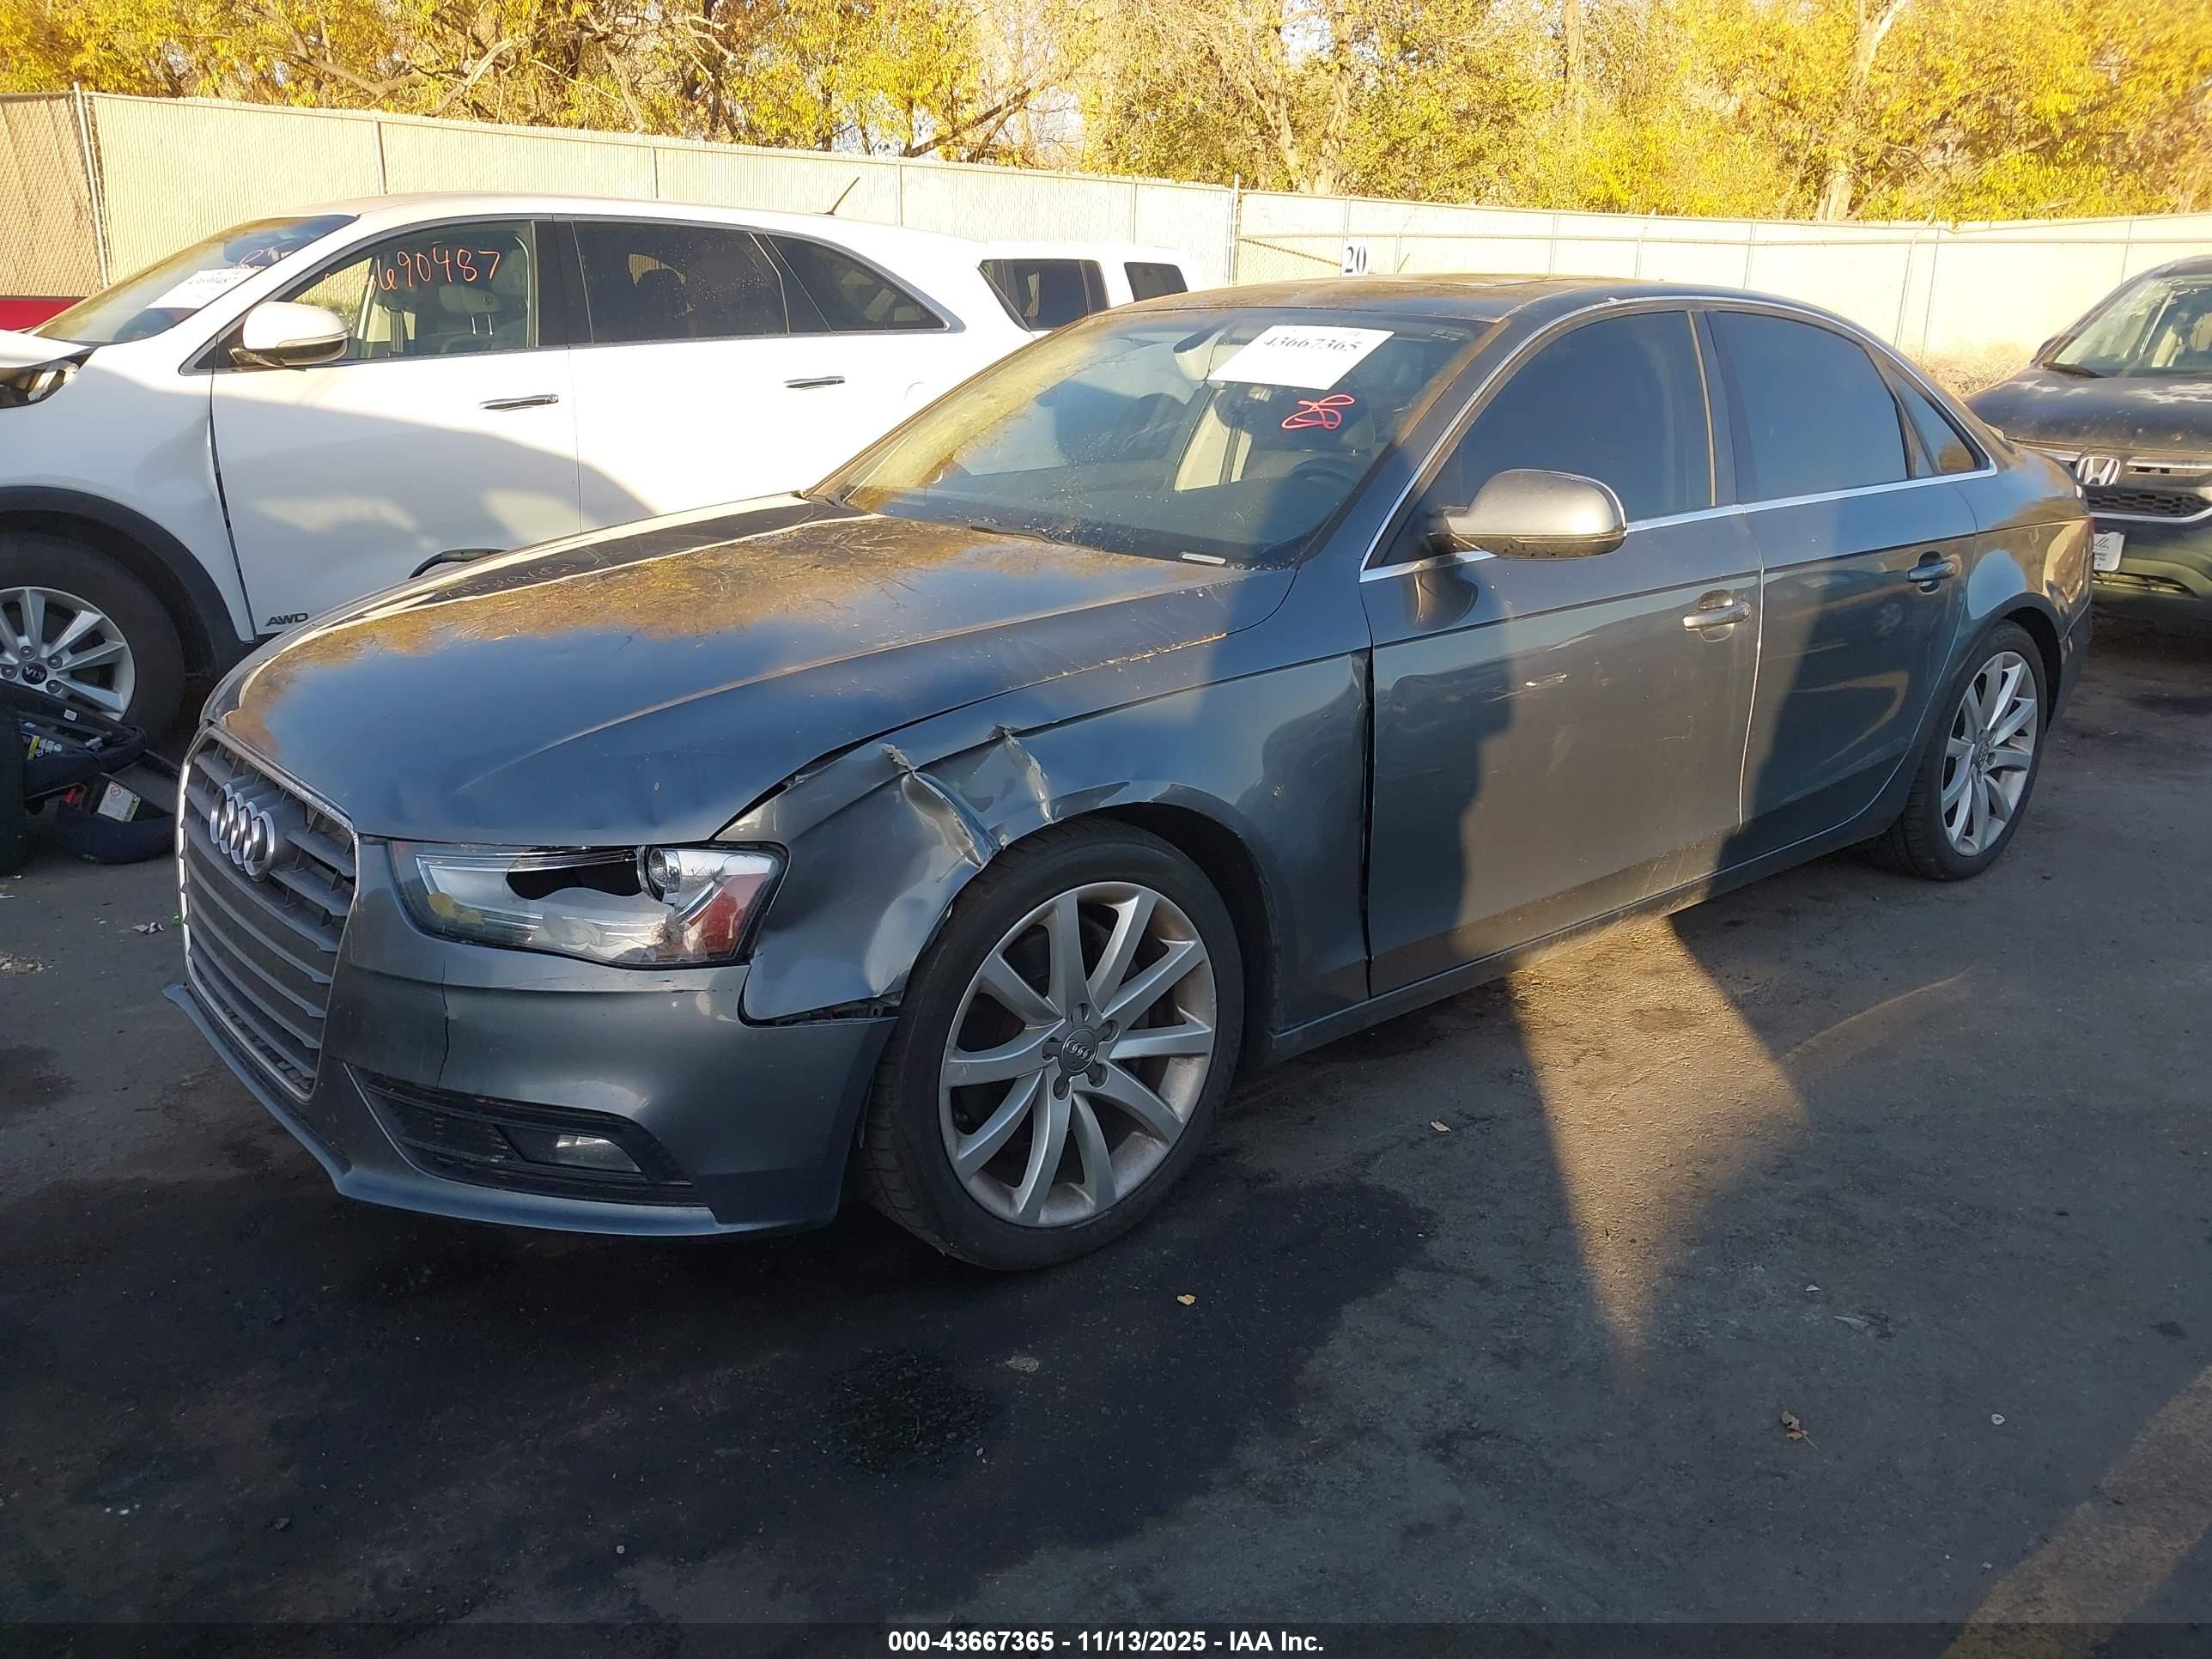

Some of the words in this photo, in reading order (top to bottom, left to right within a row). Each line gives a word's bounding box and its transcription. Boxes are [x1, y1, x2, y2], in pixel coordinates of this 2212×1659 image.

[1345, 246, 1367, 274] 20
[324, 247, 501, 297] 690487
[264, 612, 309, 627] AWD
[26, 665, 46, 680] KIA
